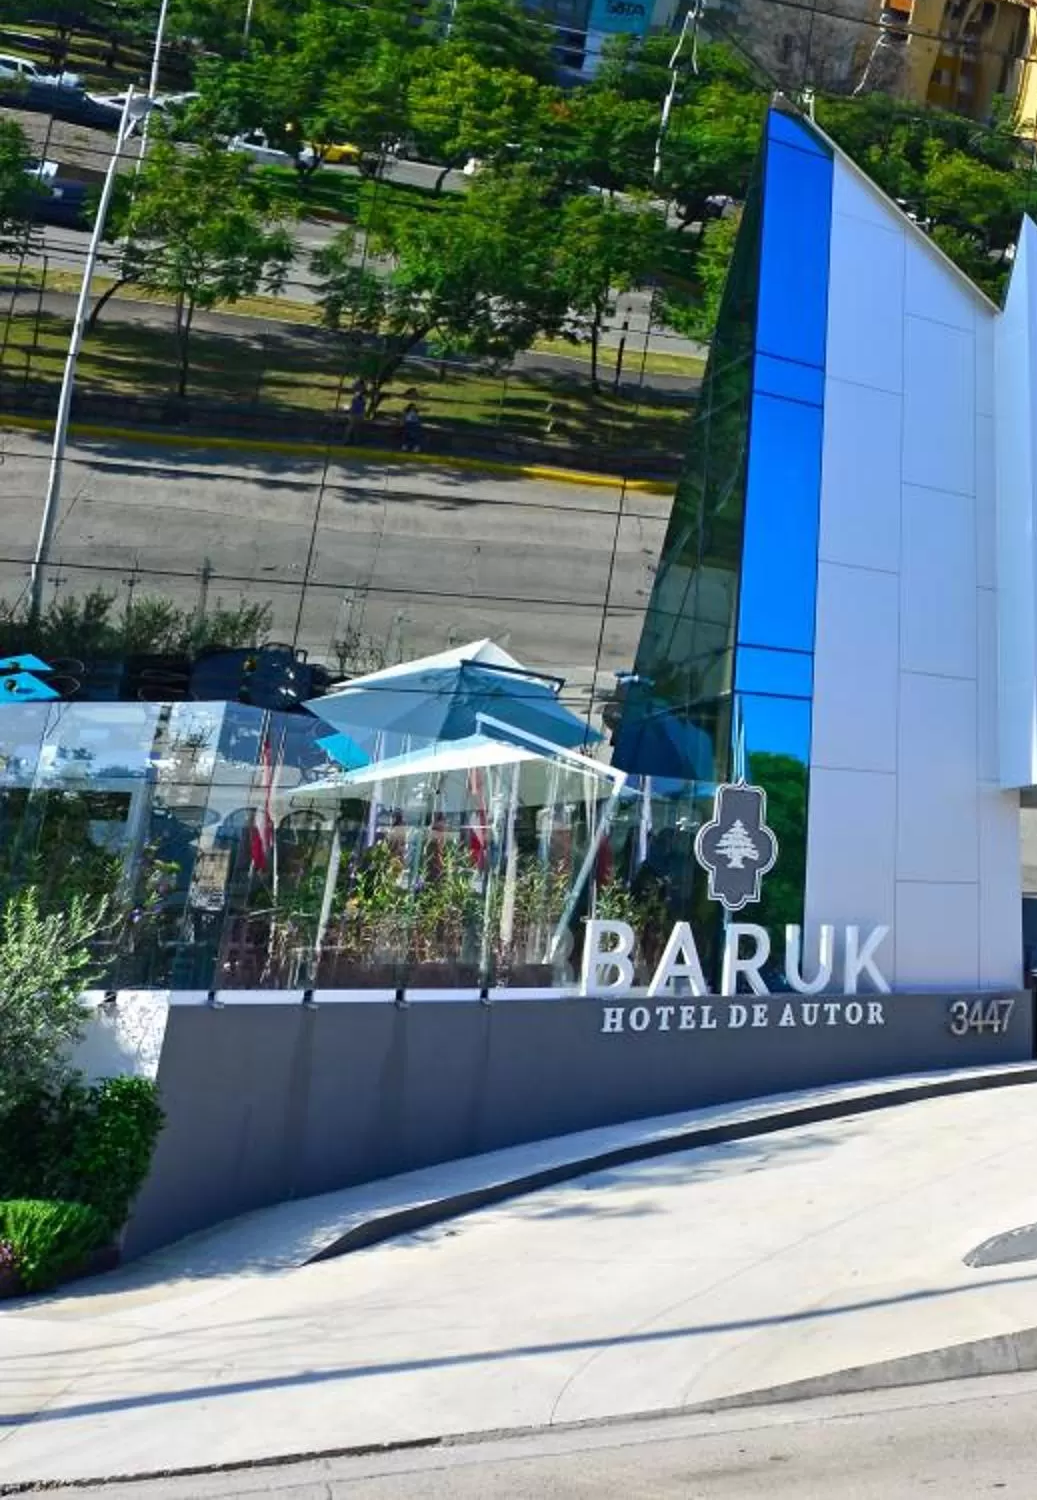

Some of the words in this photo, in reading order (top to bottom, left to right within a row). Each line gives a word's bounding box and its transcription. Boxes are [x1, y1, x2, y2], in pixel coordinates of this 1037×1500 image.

[580, 919, 891, 997] BARUK
[602, 1006, 717, 1033] HOTEL
[728, 1005, 769, 1028] DE
[778, 1003, 885, 1027] AUTOR
[949, 1000, 1014, 1035] 3447
